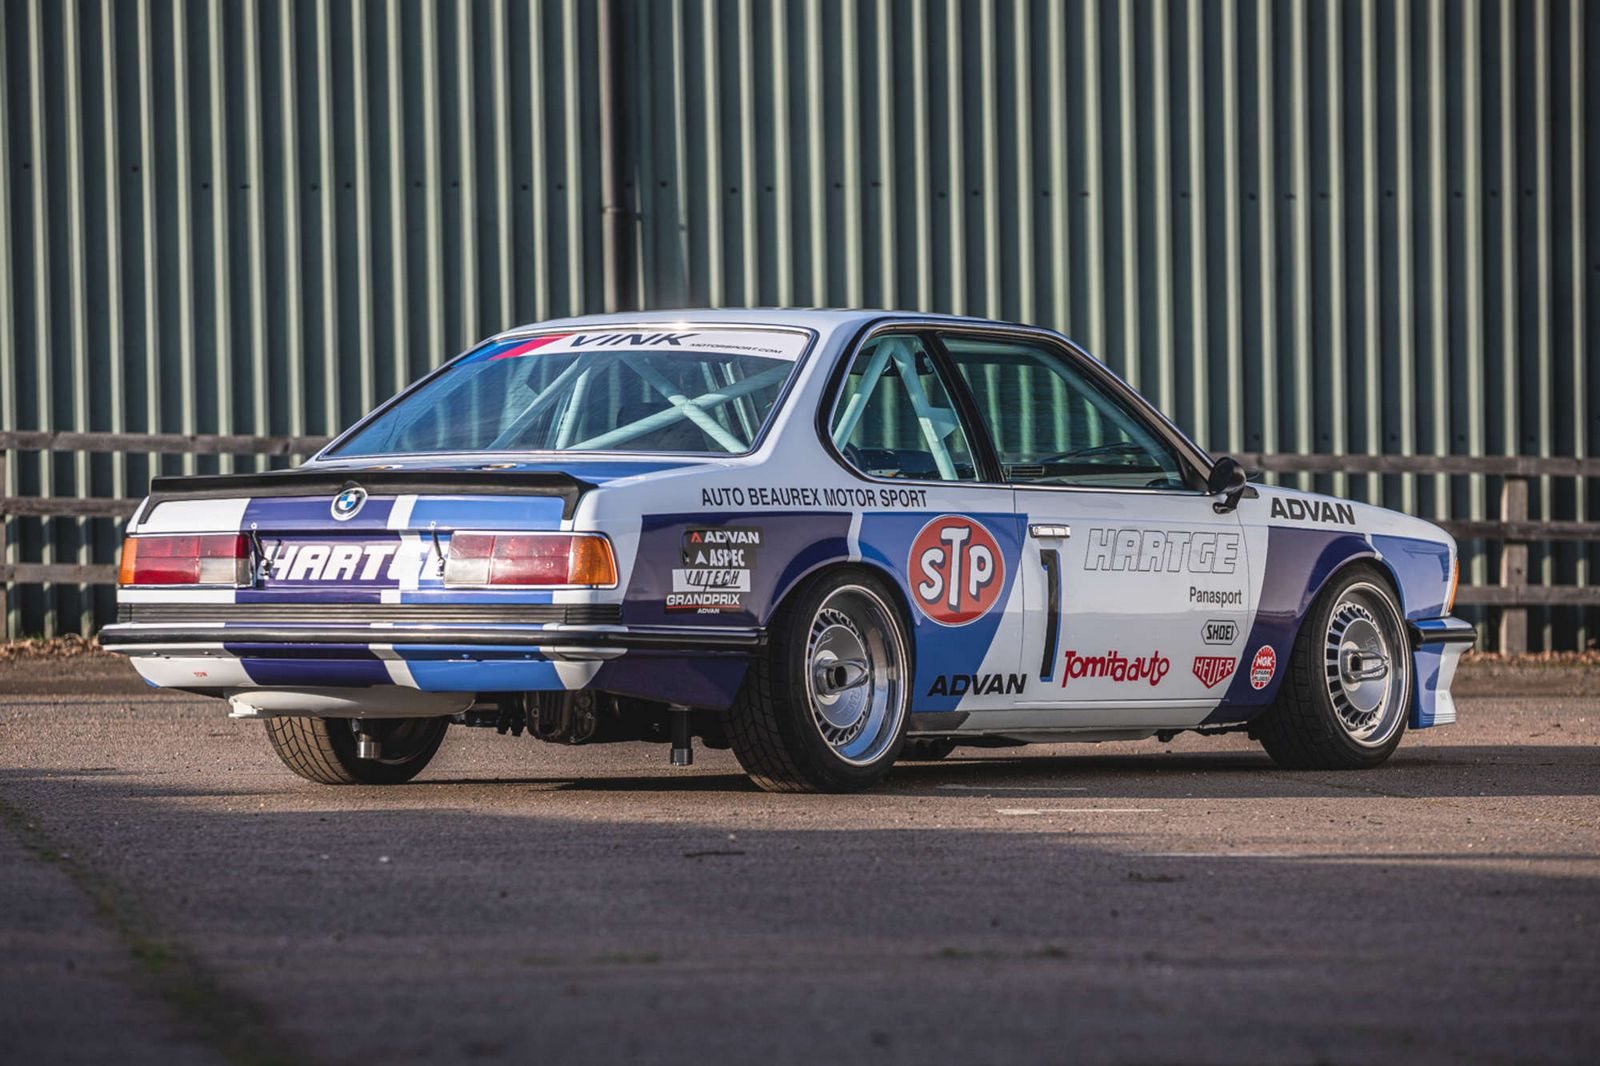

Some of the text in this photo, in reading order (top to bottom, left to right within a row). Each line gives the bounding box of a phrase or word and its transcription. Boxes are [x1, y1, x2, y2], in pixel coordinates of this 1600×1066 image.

[570, 333, 700, 347] VINK
[702, 488, 926, 507] AUTO BEAUREX MOTOR SPORT
[1270, 497, 1355, 525] ADVAN
[704, 531, 760, 544] ADVAN
[1084, 528, 1240, 574] HARTGE
[686, 570, 740, 592] INTECH
[918, 526, 996, 614] STP
[666, 594, 740, 606] GRANDPRIX
[1189, 586, 1242, 608] Panasport
[1206, 624, 1234, 640] SHOEI
[1194, 659, 1234, 685] HEUER
[1256, 656, 1273, 667] NGK
[927, 674, 1027, 697] ADVAN
